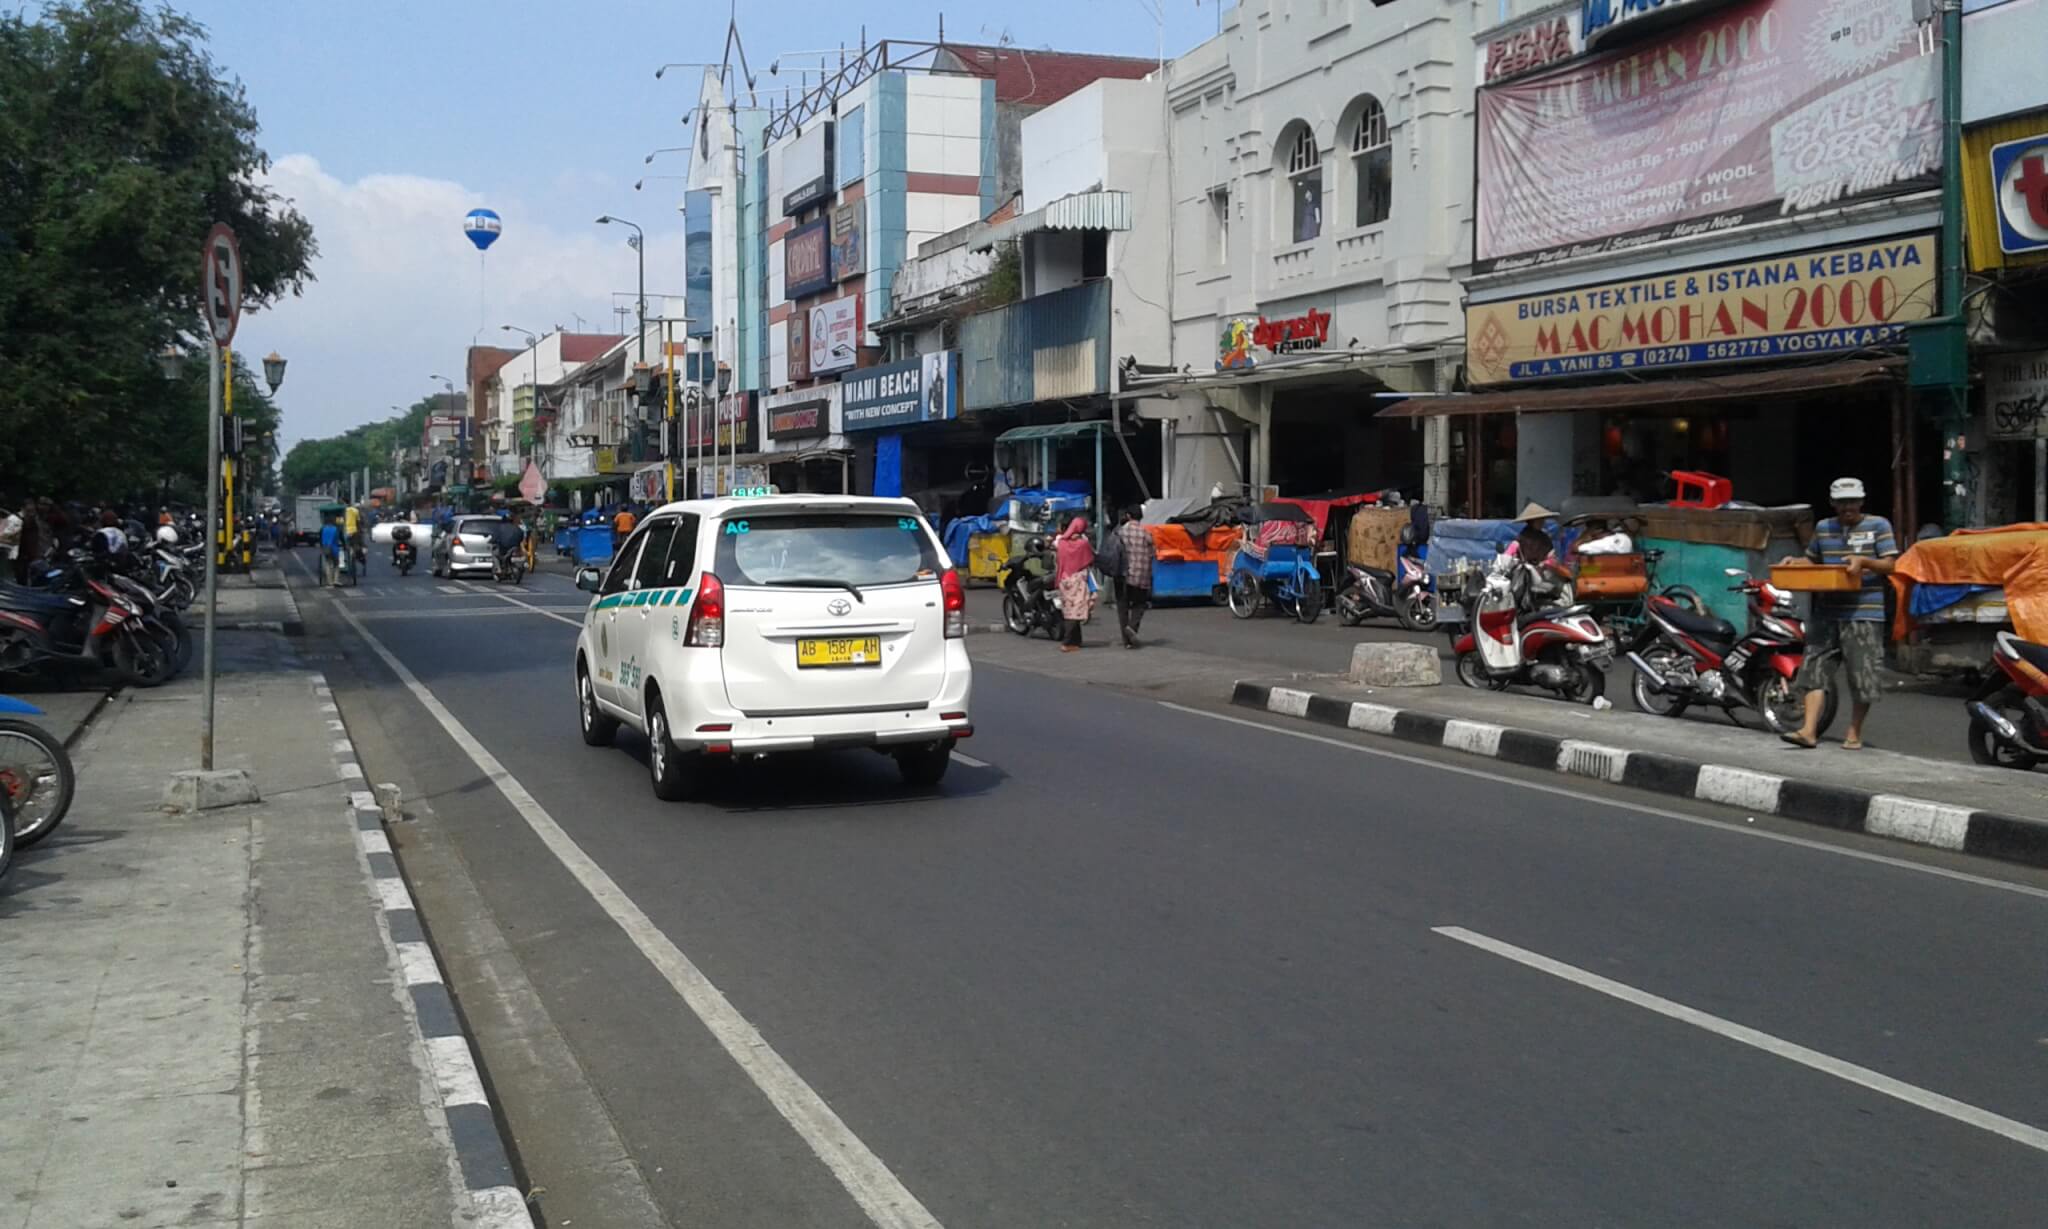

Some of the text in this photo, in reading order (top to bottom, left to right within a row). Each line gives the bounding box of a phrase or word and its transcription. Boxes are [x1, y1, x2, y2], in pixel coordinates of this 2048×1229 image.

[1485, 32, 1573, 79] KEBAYA
[1487, 16, 1571, 58] ISTANA
[1696, 9, 1783, 76] 2000
[1783, 80, 1898, 152] SALE
[1795, 103, 1938, 172] OBRAL
[1641, 154, 1663, 174] Rp
[1706, 163, 1757, 185] WOOL
[1701, 189, 1734, 206] DLL
[1518, 244, 1921, 320] BURSA TEXTILE & ISTANA KEBAYA
[1534, 275, 1897, 357] MAC MOHAN 2000
[1518, 325, 1909, 376] JL. A. YANI 85 (0274) 562779 YOGYAKART
[845, 369, 920, 404] MIAMI BEACH
[865, 405, 882, 419] NEW
[725, 520, 750, 535] AC
[898, 519, 919, 530] 52
[802, 638, 878, 656] AB 1587 AH
